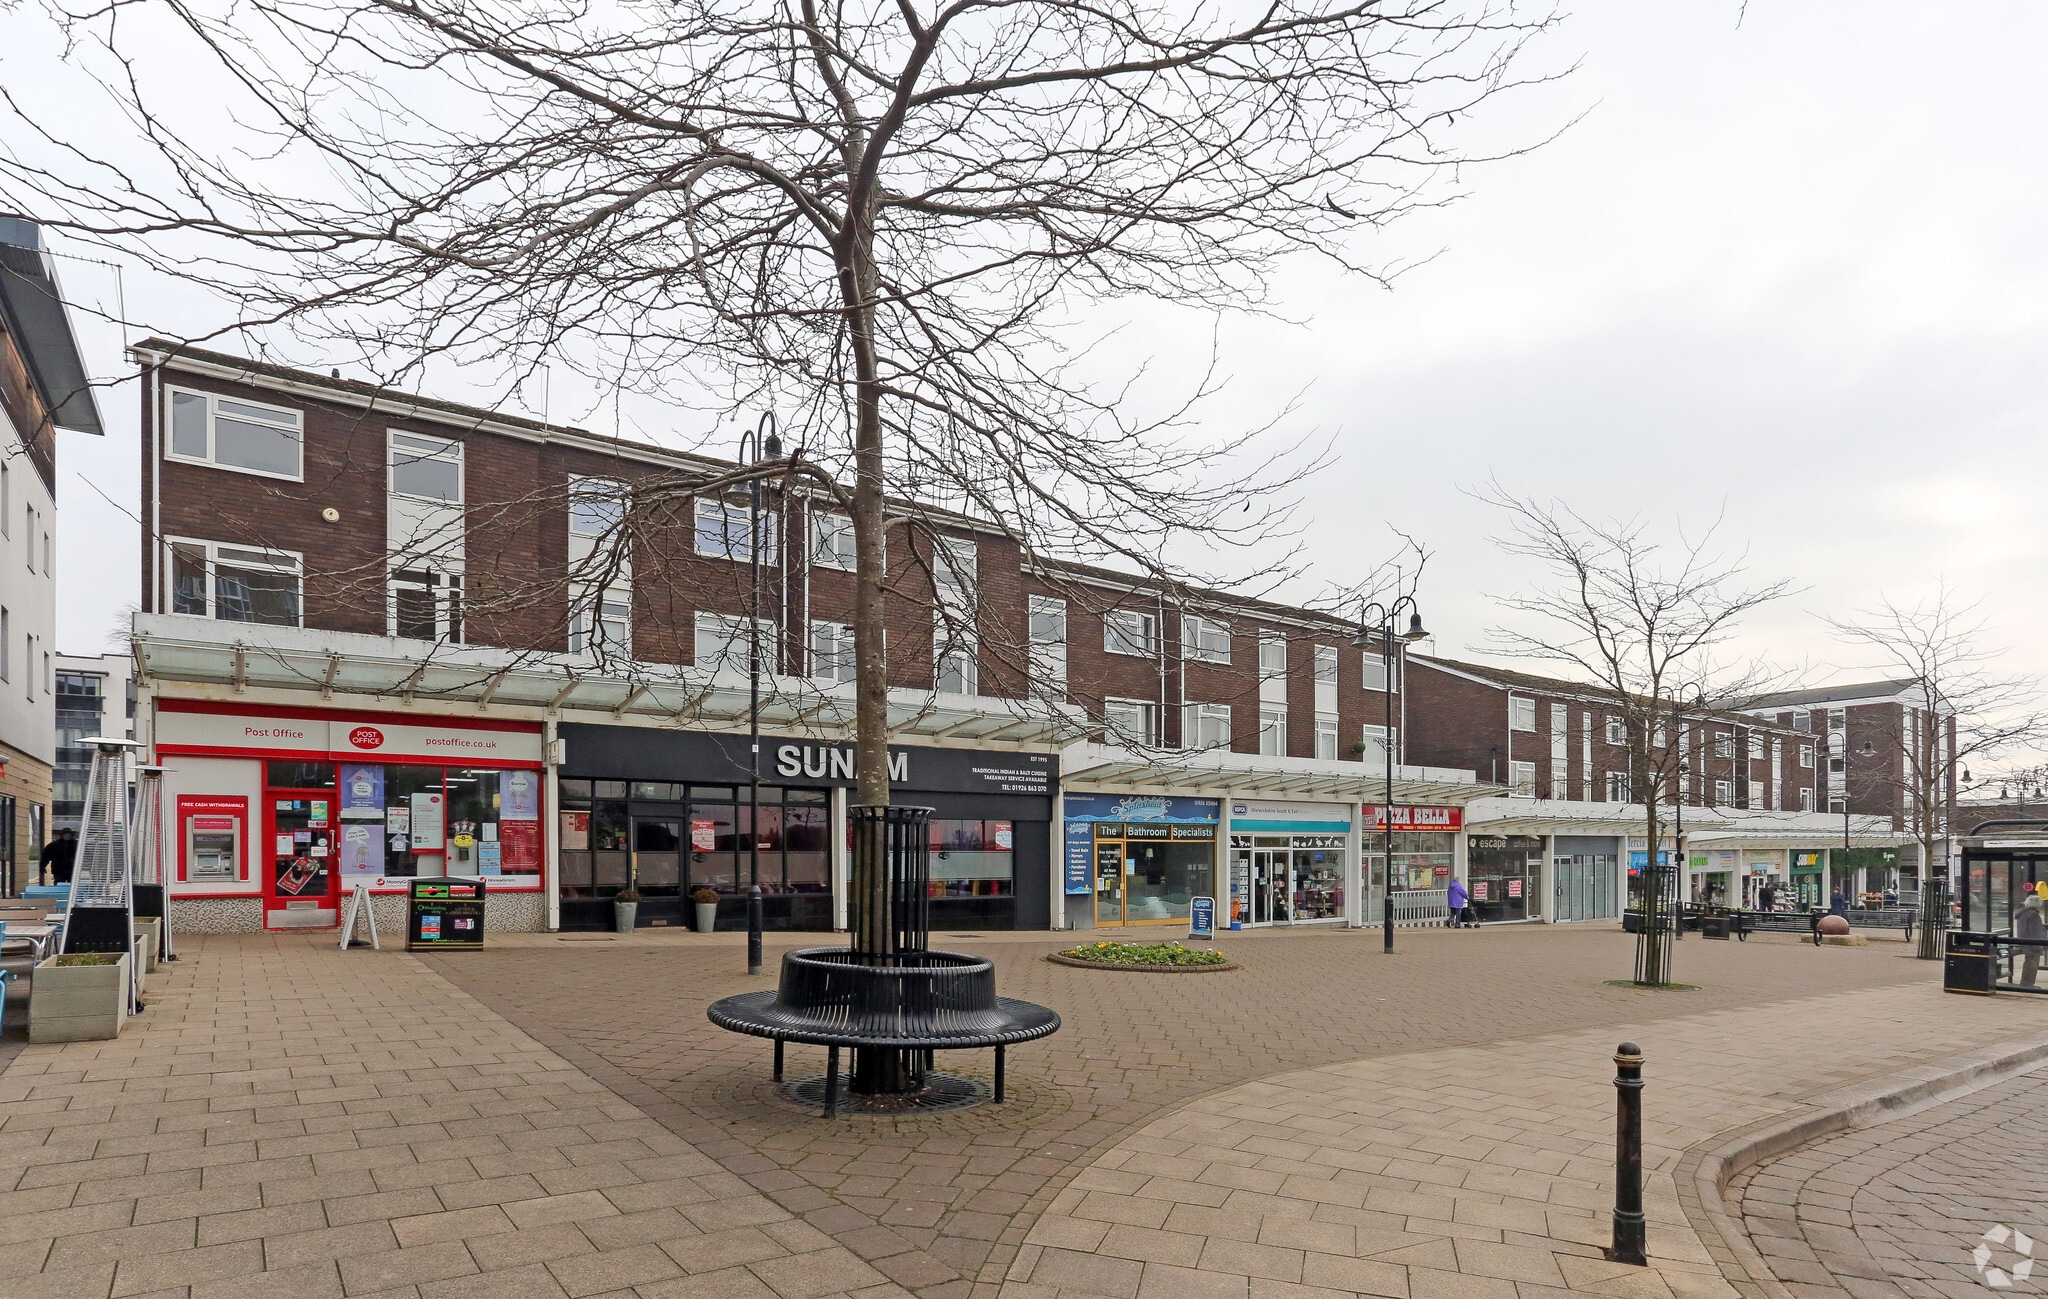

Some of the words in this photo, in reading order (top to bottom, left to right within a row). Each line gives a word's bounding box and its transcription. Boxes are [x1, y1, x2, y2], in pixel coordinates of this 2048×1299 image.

[245, 727, 269, 737] Post
[272, 728, 304, 739] Office
[356, 730, 377, 738] POST
[352, 736, 380, 745] OFFICE
[425, 737, 497, 749] postoffice.co.uk
[777, 745, 908, 782] SUNM
[1375, 807, 1411, 824] PIZZA
[1414, 808, 1450, 825] BELLA
[1101, 826, 1117, 836] The
[1128, 826, 1167, 837] Bathroom
[1172, 827, 1213, 838] Specialists
[1480, 839, 1507, 850] escape
[1513, 840, 1526, 848] coffee
